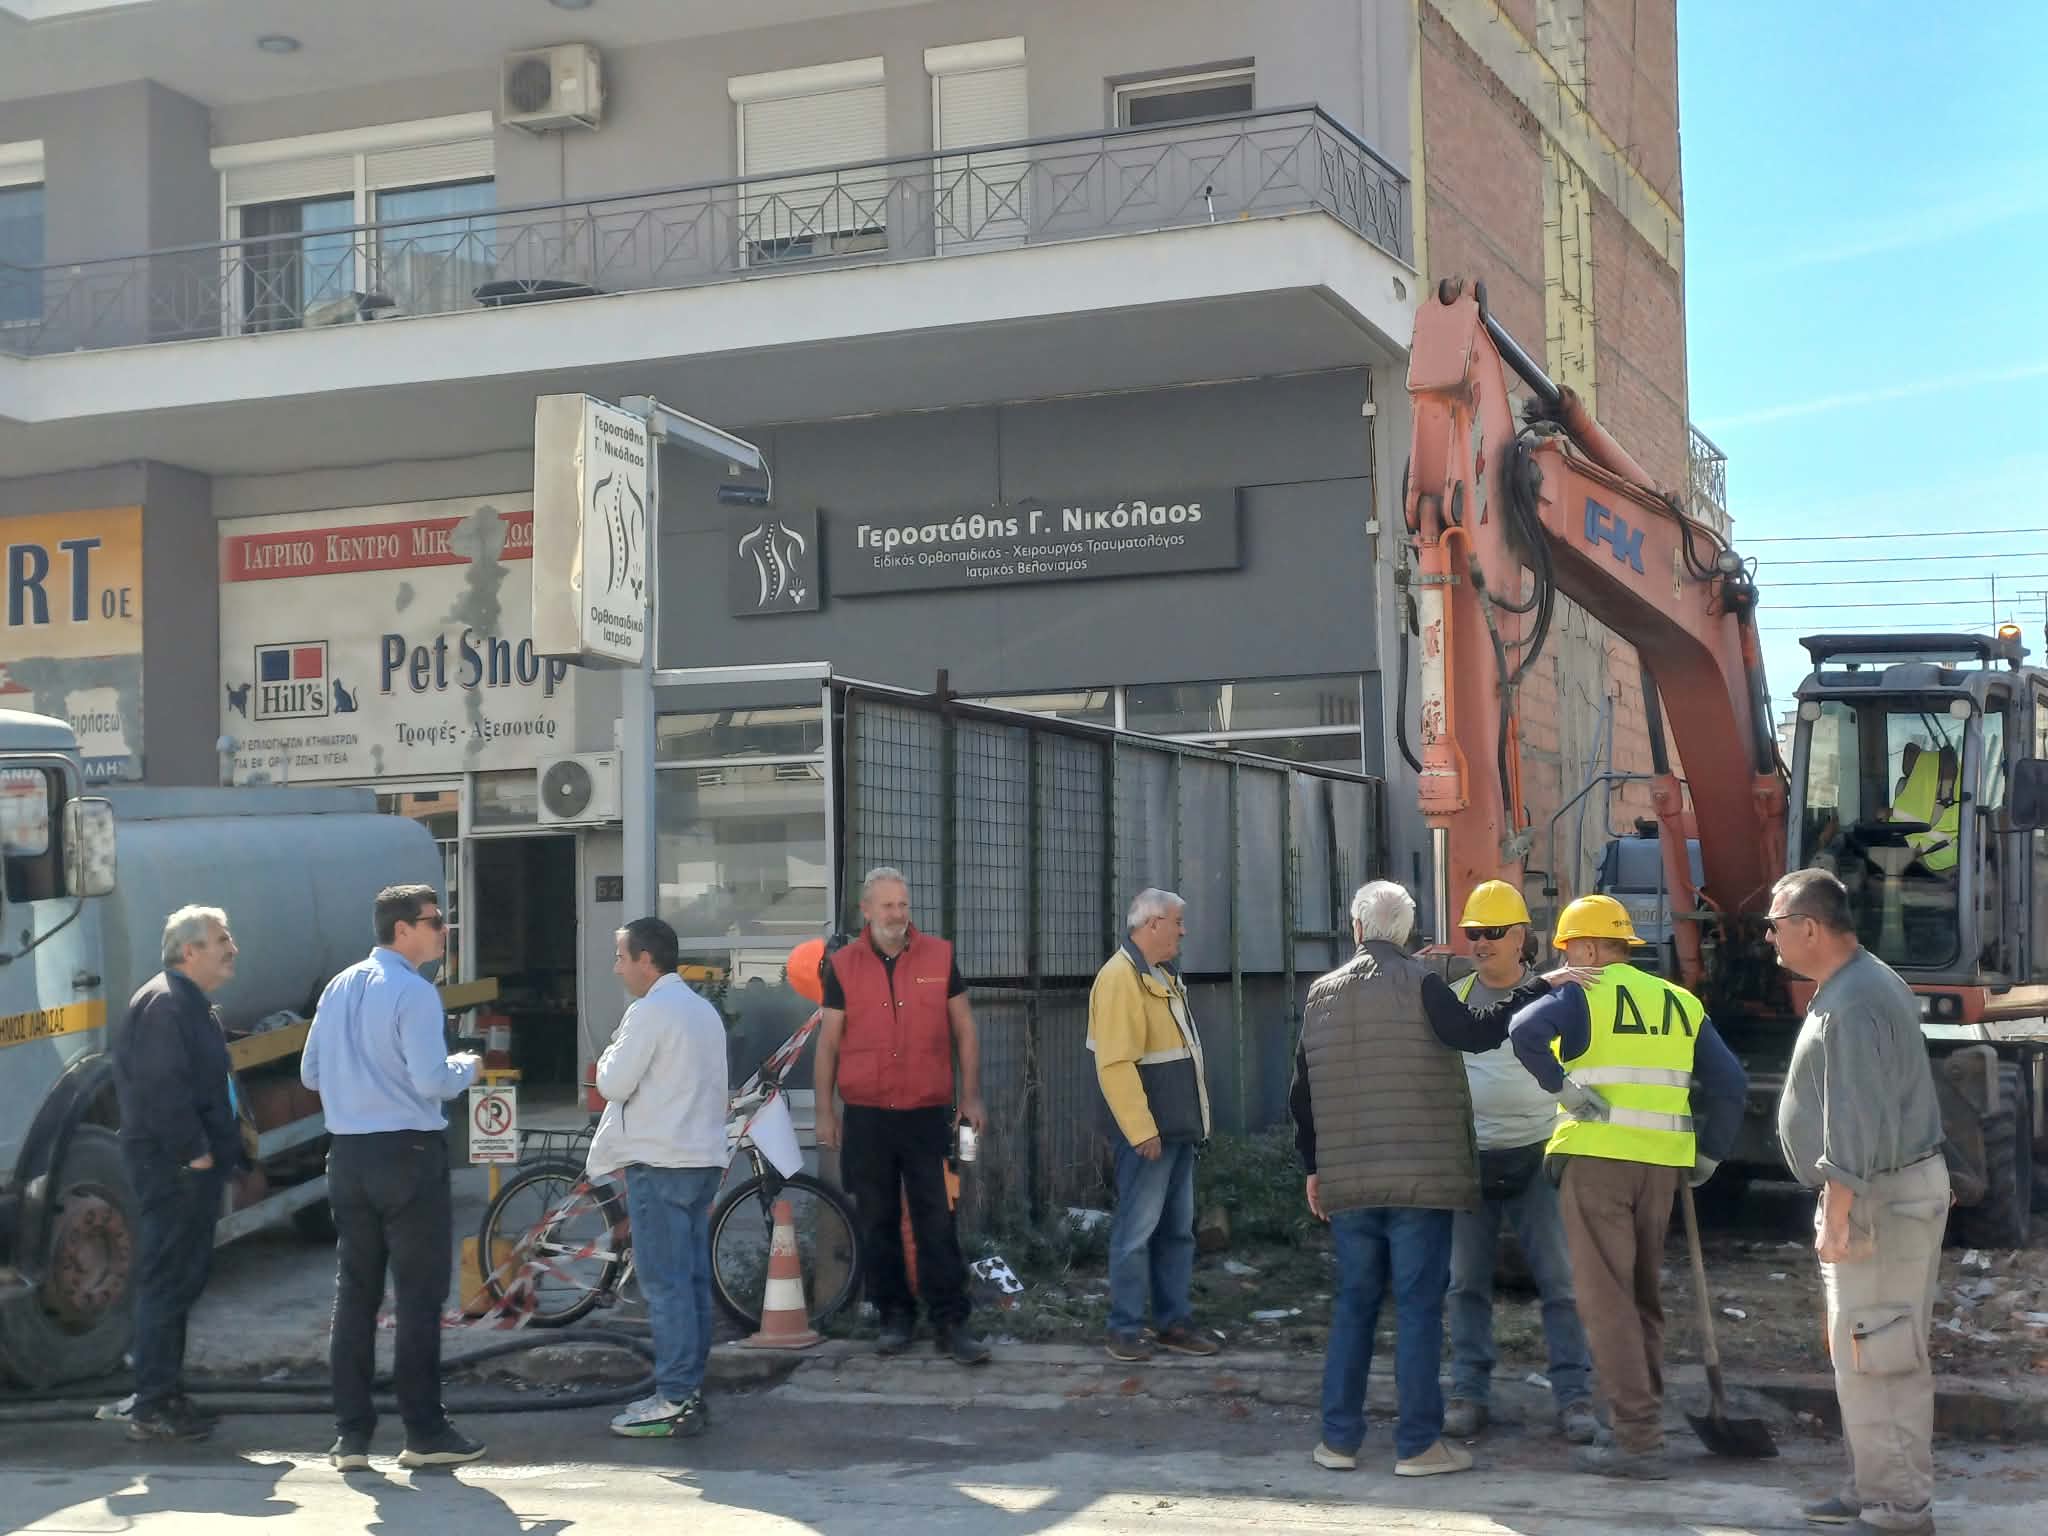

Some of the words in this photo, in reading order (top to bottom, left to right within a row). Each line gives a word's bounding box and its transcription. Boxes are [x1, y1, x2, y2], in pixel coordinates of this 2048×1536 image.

[594, 415, 644, 446] Γεροστάθης
[604, 440, 644, 467] Νικόλαος
[857, 513, 1018, 552] Γεροστάθης
[1029, 510, 1051, 535] Γ.
[1062, 500, 1202, 532] Νικόλαος
[873, 553, 915, 568] Ειδικός
[918, 547, 1001, 566] Ορθοπαιδικός
[1013, 541, 1083, 558] Χειρουργός
[1087, 534, 1185, 553] Τραυματολόγος
[966, 564, 1014, 580] Ιατρικός
[1018, 558, 1088, 574] Βελονισμός
[380, 632, 449, 695] Pet
[262, 683, 324, 713] Hill's
[395, 719, 456, 747] Τροφές
[472, 713, 556, 742] Αξεσουάρ
